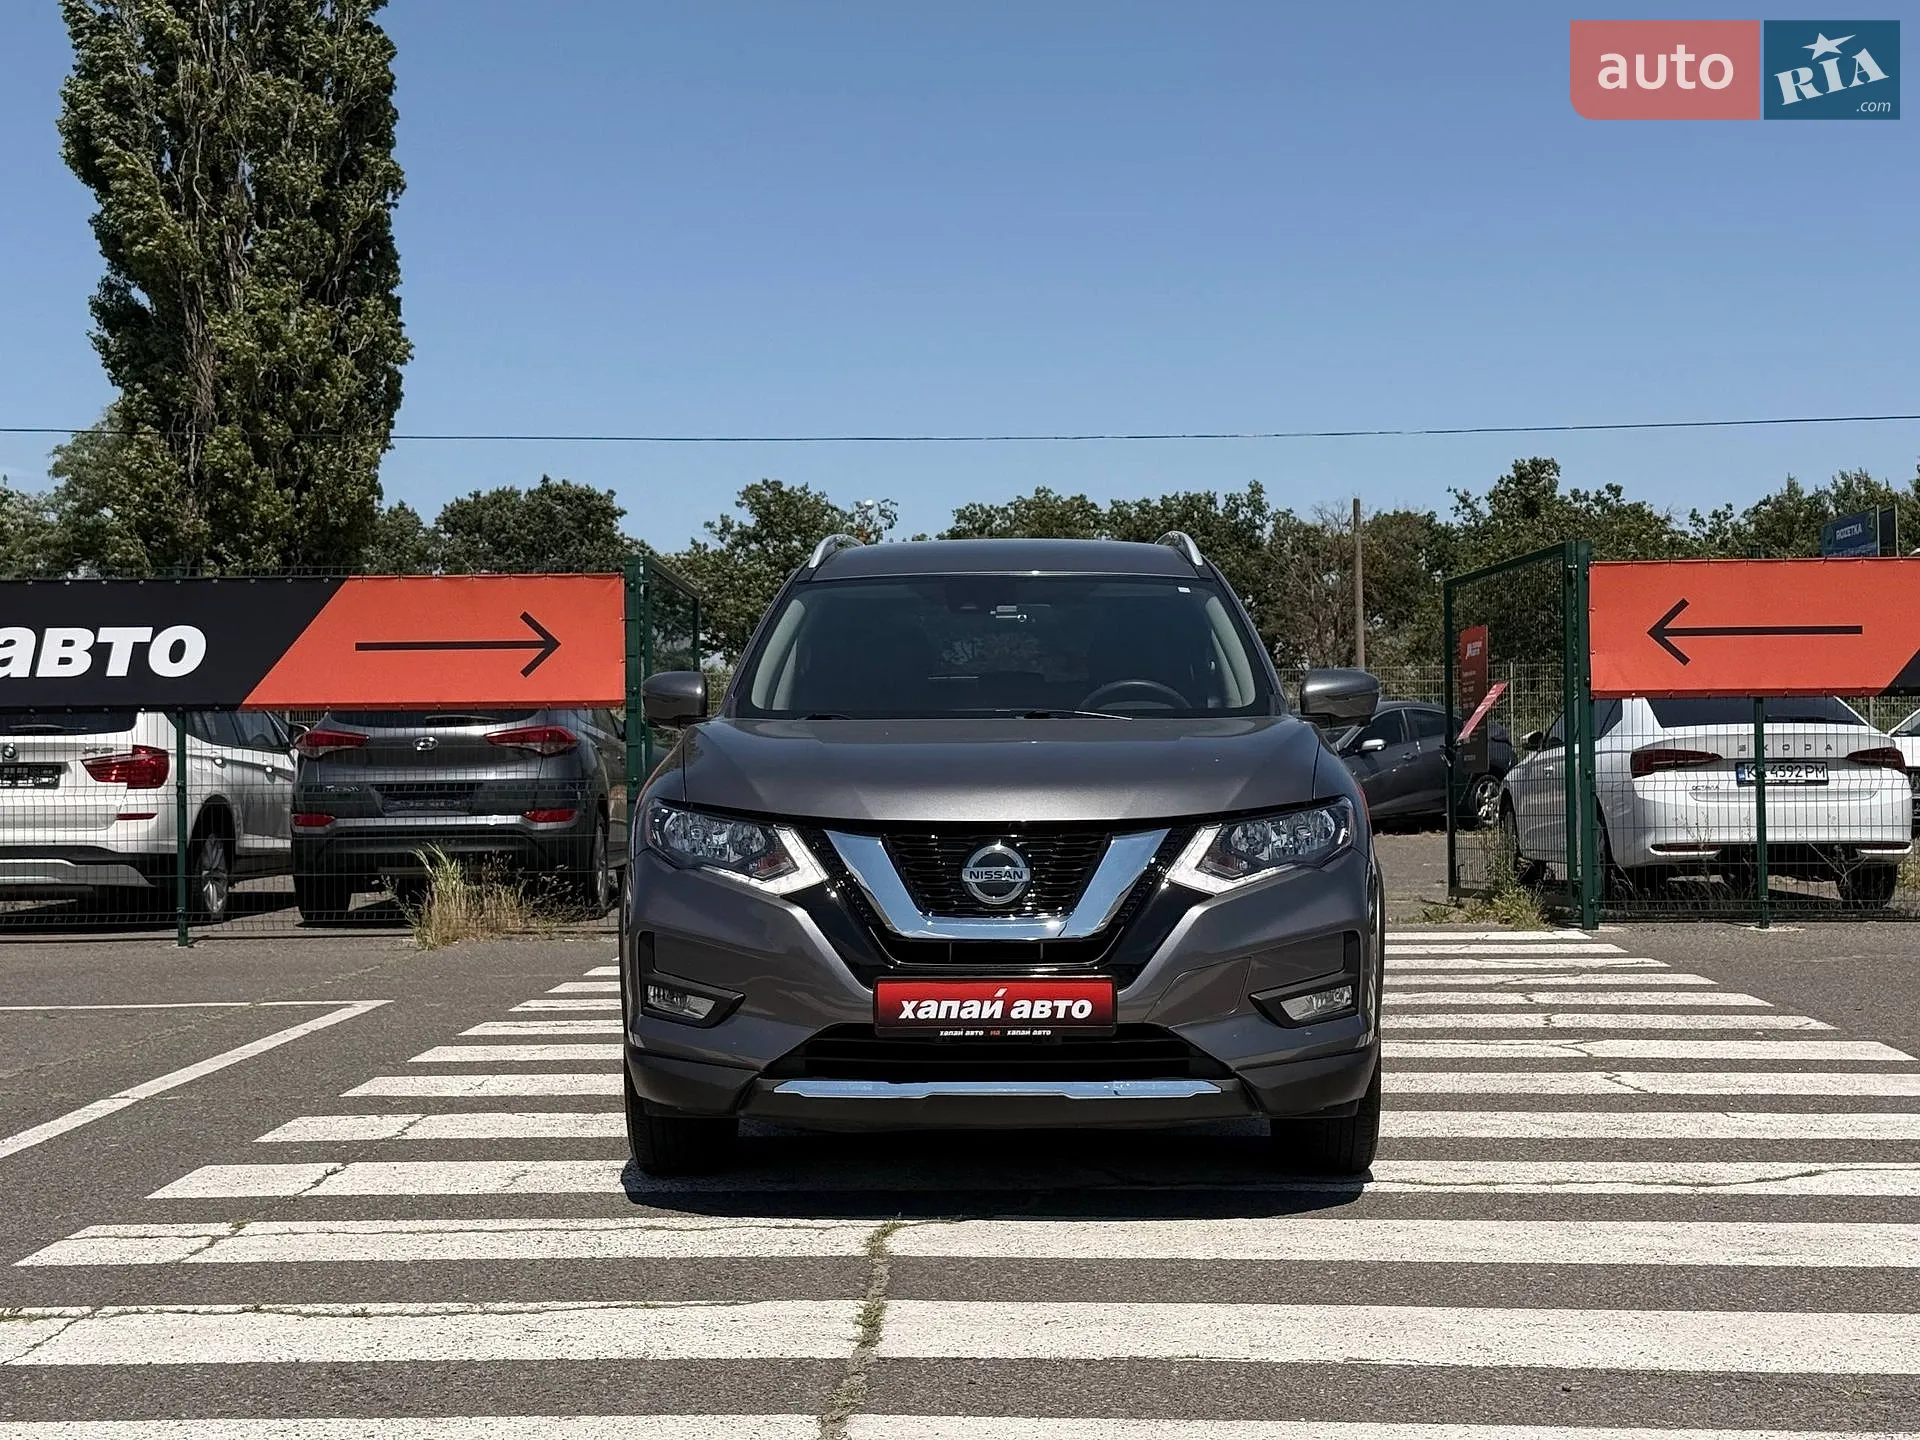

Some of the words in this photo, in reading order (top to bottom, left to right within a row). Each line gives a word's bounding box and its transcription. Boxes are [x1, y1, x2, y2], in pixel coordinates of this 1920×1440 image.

[0, 624, 207, 679] авто
[969, 870, 1024, 880] NISSAN
[1010, 999, 1093, 1019] авто
